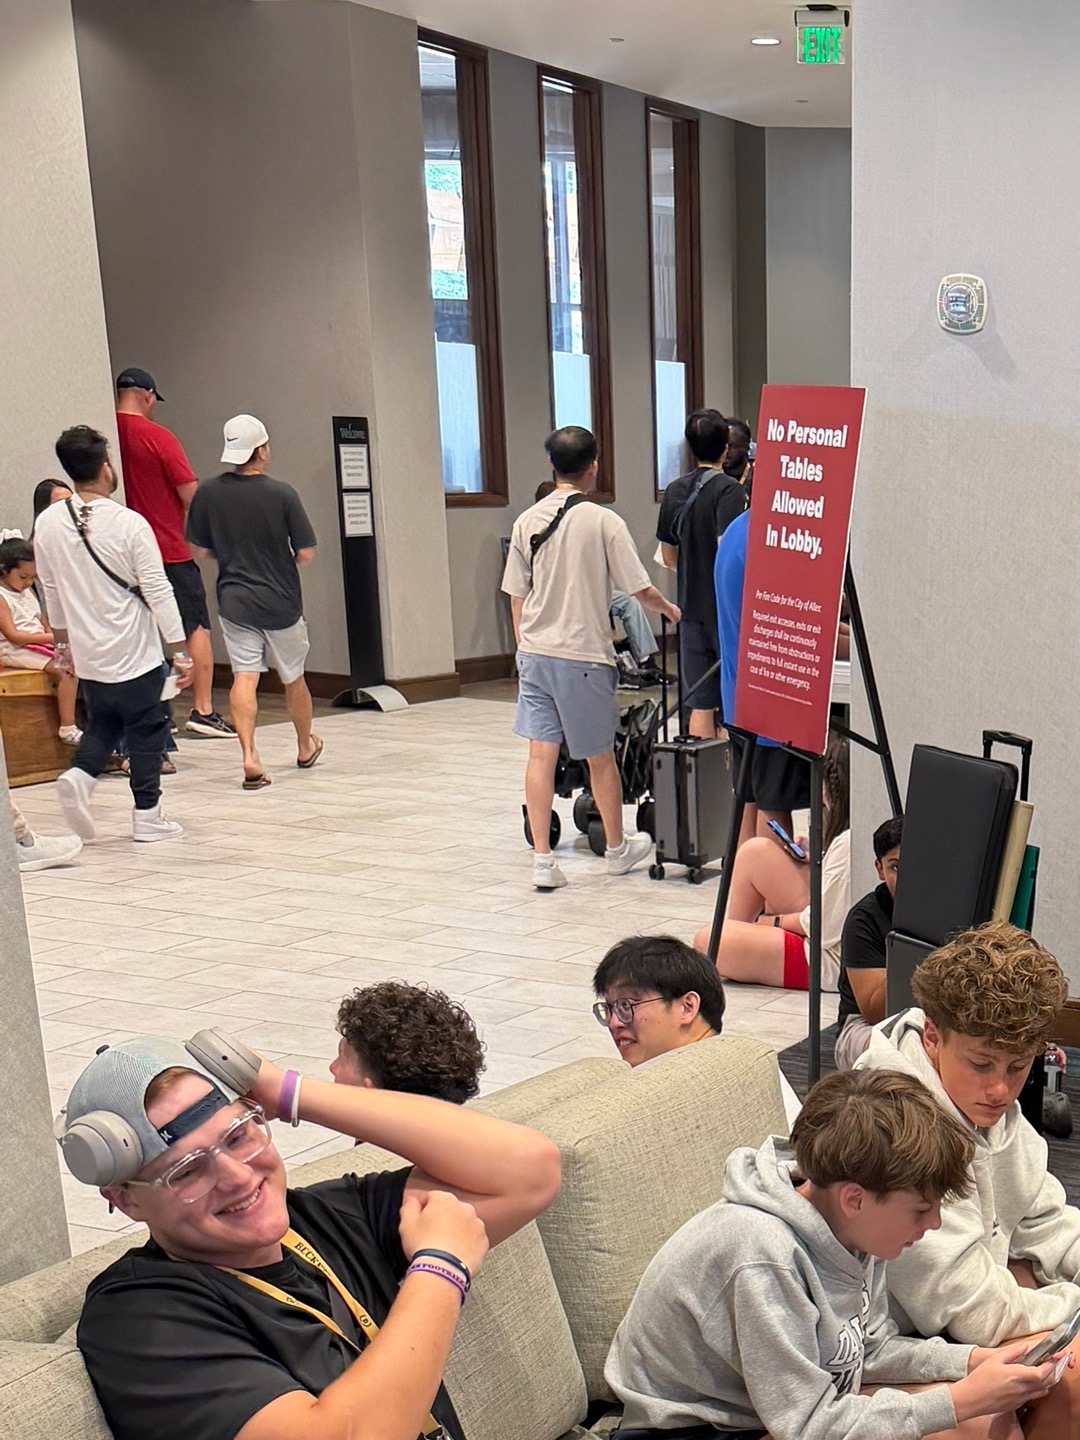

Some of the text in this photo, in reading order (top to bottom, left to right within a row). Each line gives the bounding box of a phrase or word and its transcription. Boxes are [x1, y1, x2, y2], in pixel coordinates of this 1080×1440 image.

[803, 27, 842, 64] EXIT
[767, 418, 848, 449] No Personal
[780, 454, 824, 483] Tables
[771, 489, 824, 519] Allowed
[765, 523, 823, 560] In Lobby.
[770, 592, 780, 604] Code
[795, 598, 804, 611] City
